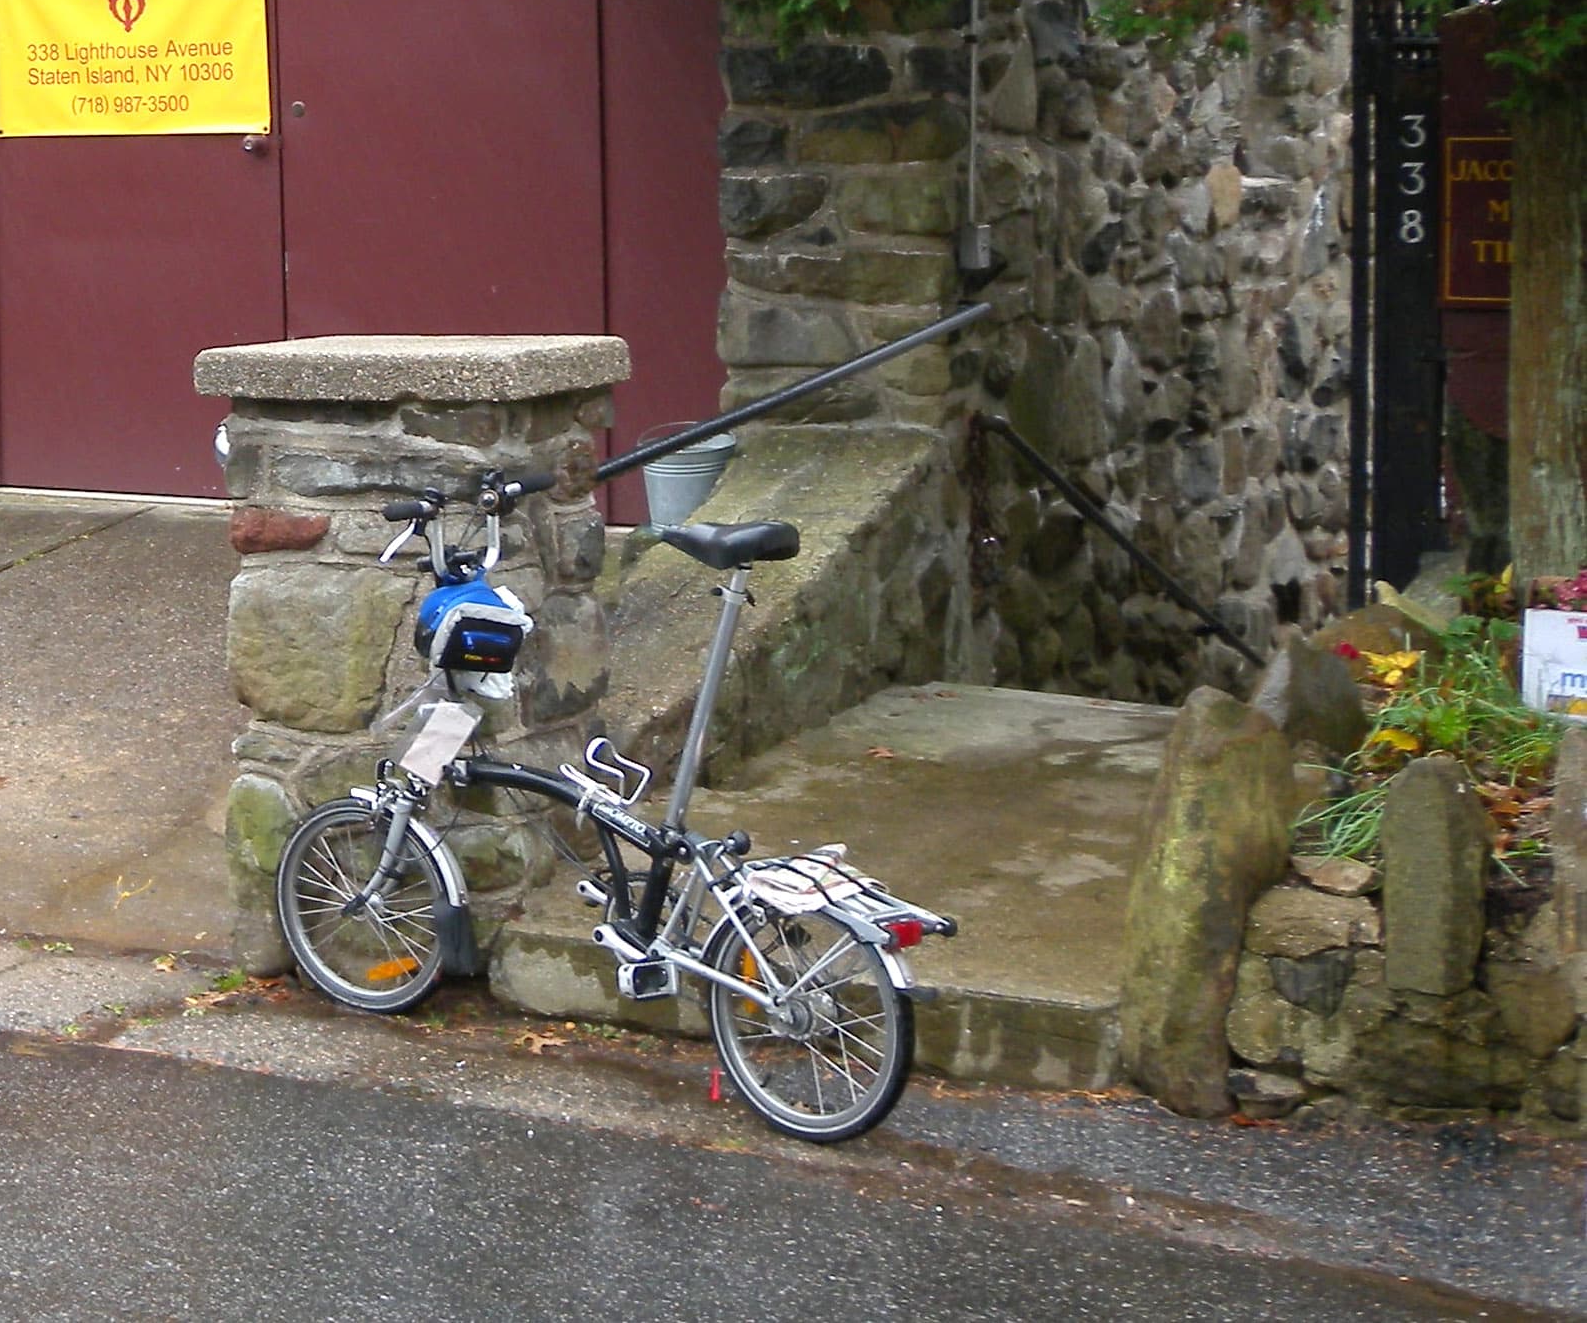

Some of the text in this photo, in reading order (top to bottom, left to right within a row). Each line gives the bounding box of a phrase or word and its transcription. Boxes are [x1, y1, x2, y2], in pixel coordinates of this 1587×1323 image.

[27, 39, 233, 64] 338 Lighthouse Avenue
[28, 62, 234, 85] Staten Island, NY 10306
[71, 94, 189, 115] (718) 987-3500
